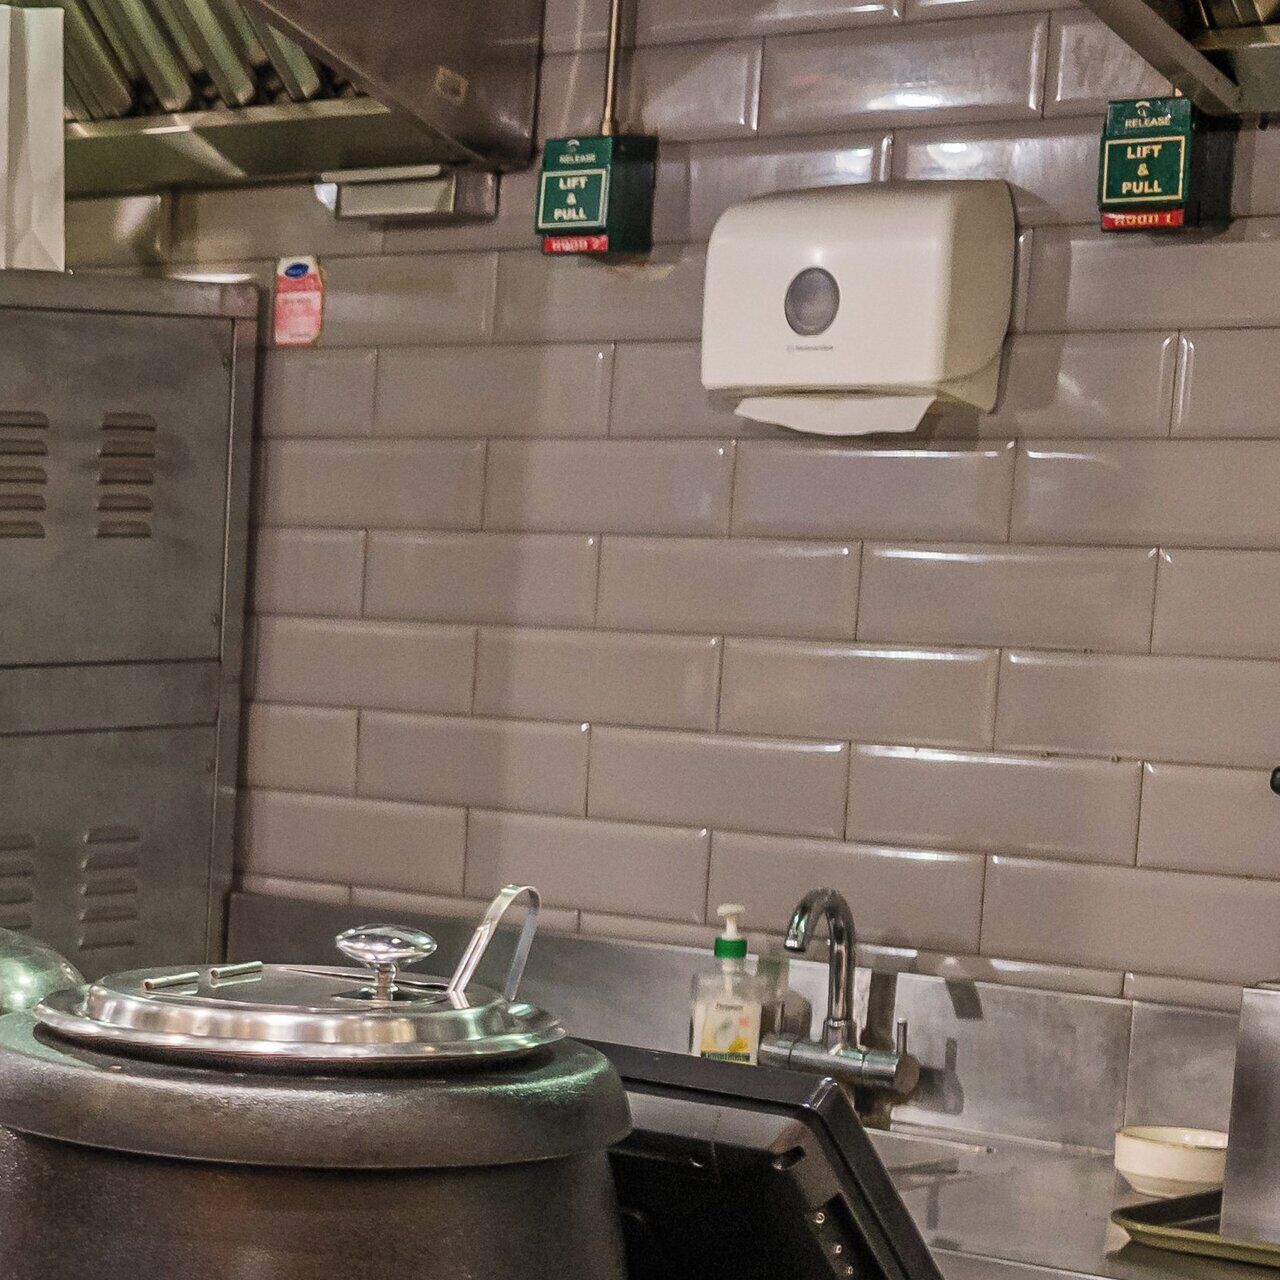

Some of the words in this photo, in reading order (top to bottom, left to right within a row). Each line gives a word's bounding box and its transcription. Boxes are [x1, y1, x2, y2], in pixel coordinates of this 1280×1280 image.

[1124, 115, 1172, 128] RELEASE
[1126, 144, 1163, 159] LIFT
[1137, 163, 1149, 177] &
[558, 176, 588, 190] LIFT
[1122, 179, 1163, 194] PULL
[553, 207, 587, 220] PULL
